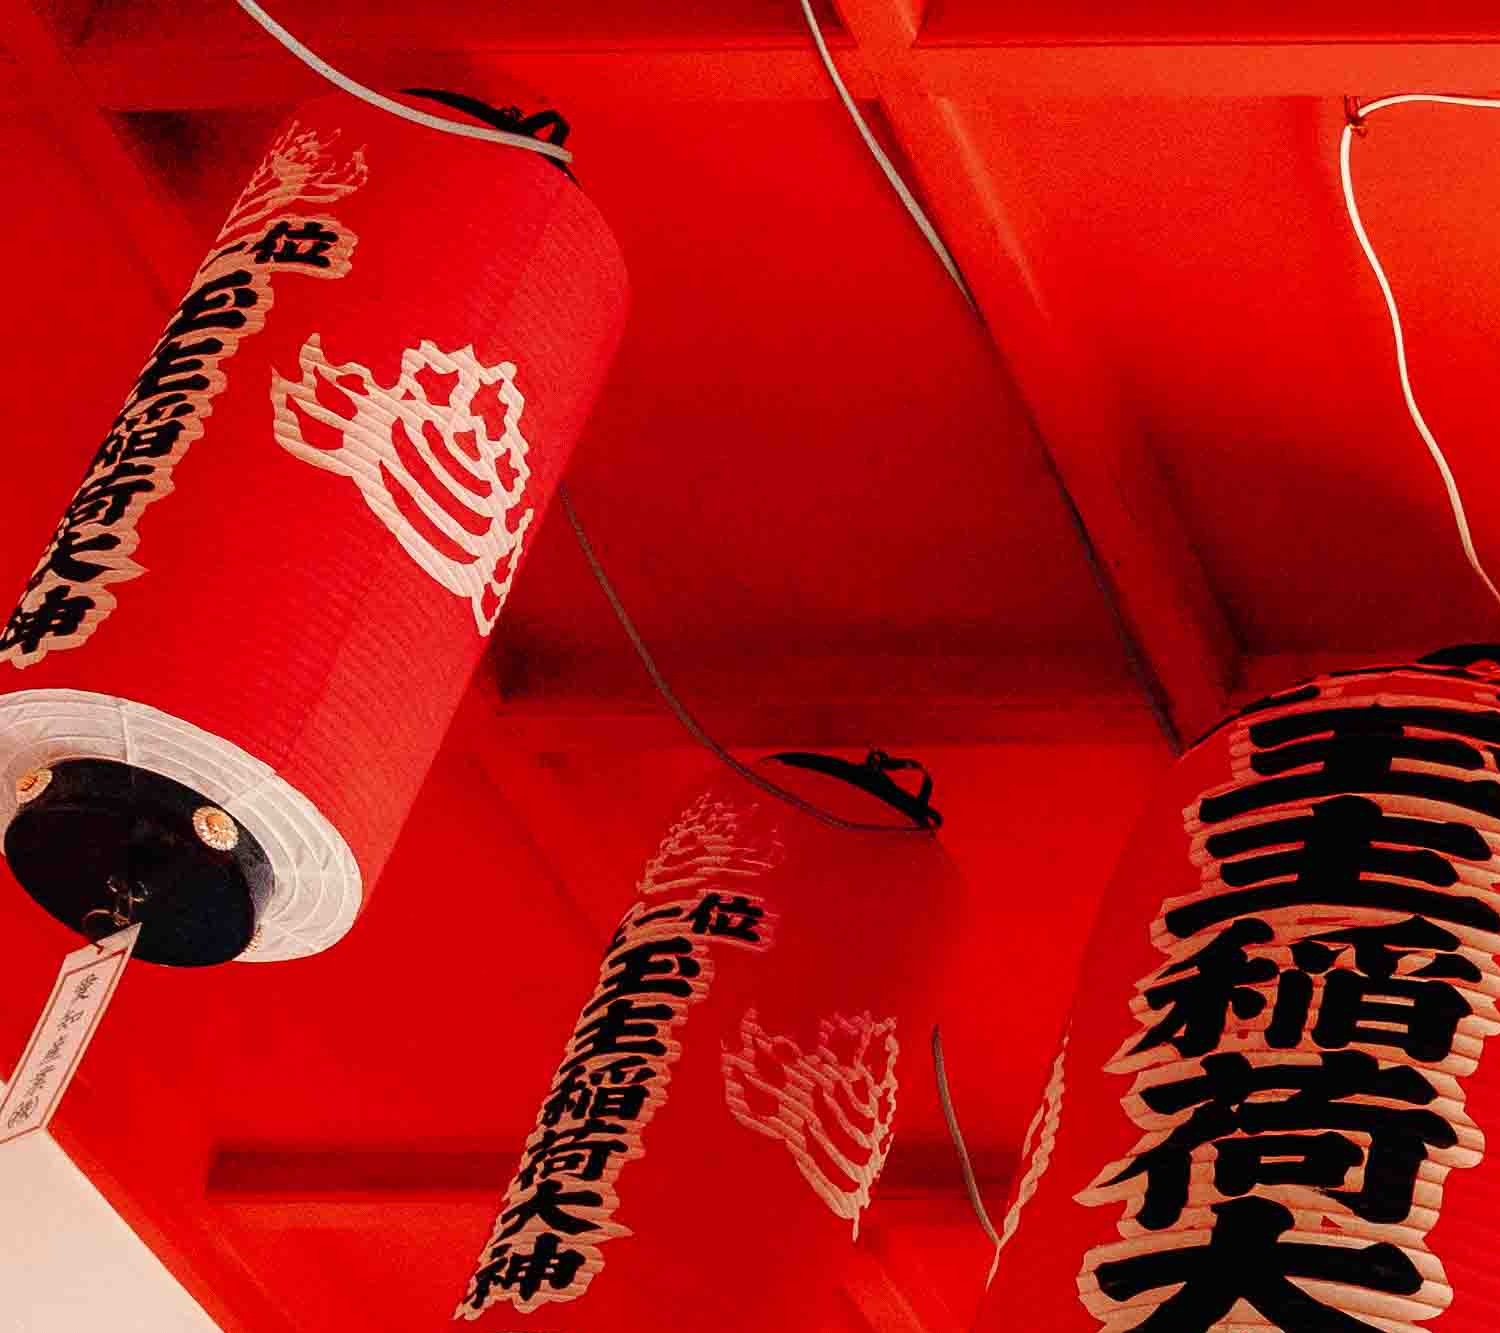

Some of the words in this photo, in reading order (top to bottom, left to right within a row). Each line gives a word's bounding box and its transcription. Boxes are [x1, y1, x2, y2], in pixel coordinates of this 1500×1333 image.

[205, 222, 340, 270] 一位
[467, 938, 702, 1307] 玉主稲荷大神
